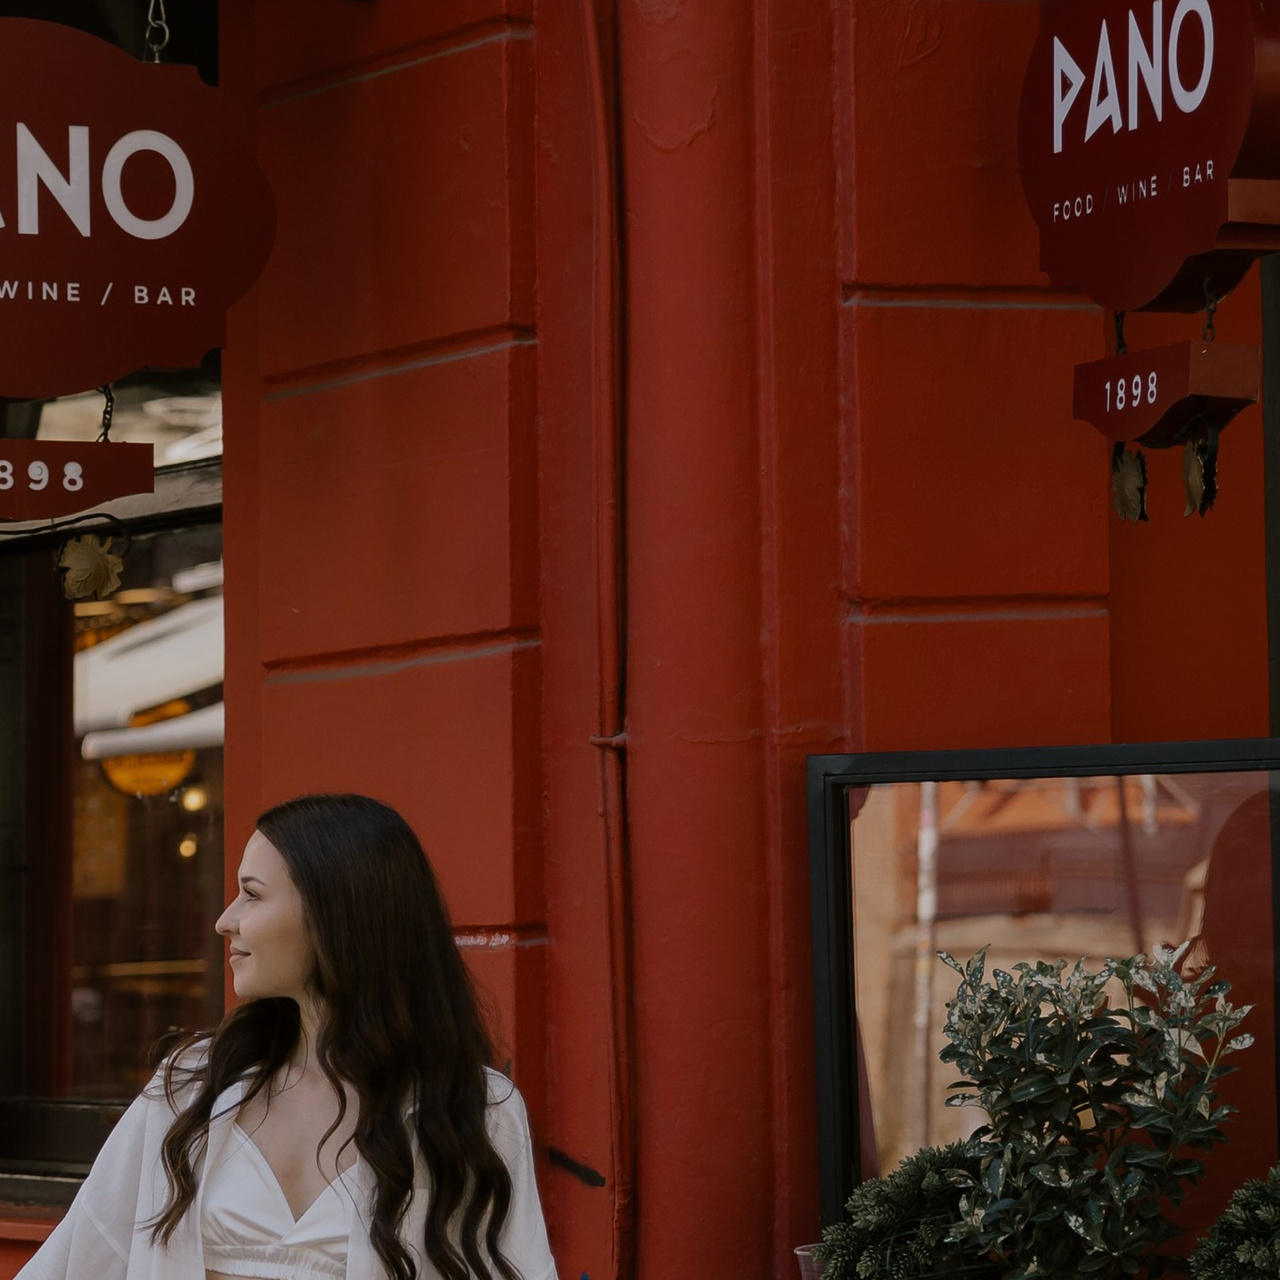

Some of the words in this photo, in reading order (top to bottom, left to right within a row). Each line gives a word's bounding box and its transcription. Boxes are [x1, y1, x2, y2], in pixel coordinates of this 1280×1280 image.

[1053, 193, 1094, 223] FOOD
[1117, 175, 1158, 206] WINE
[1182, 159, 1215, 188] BAR
[134, 285, 196, 307] BAR
[1104, 371, 1158, 413] 1898
